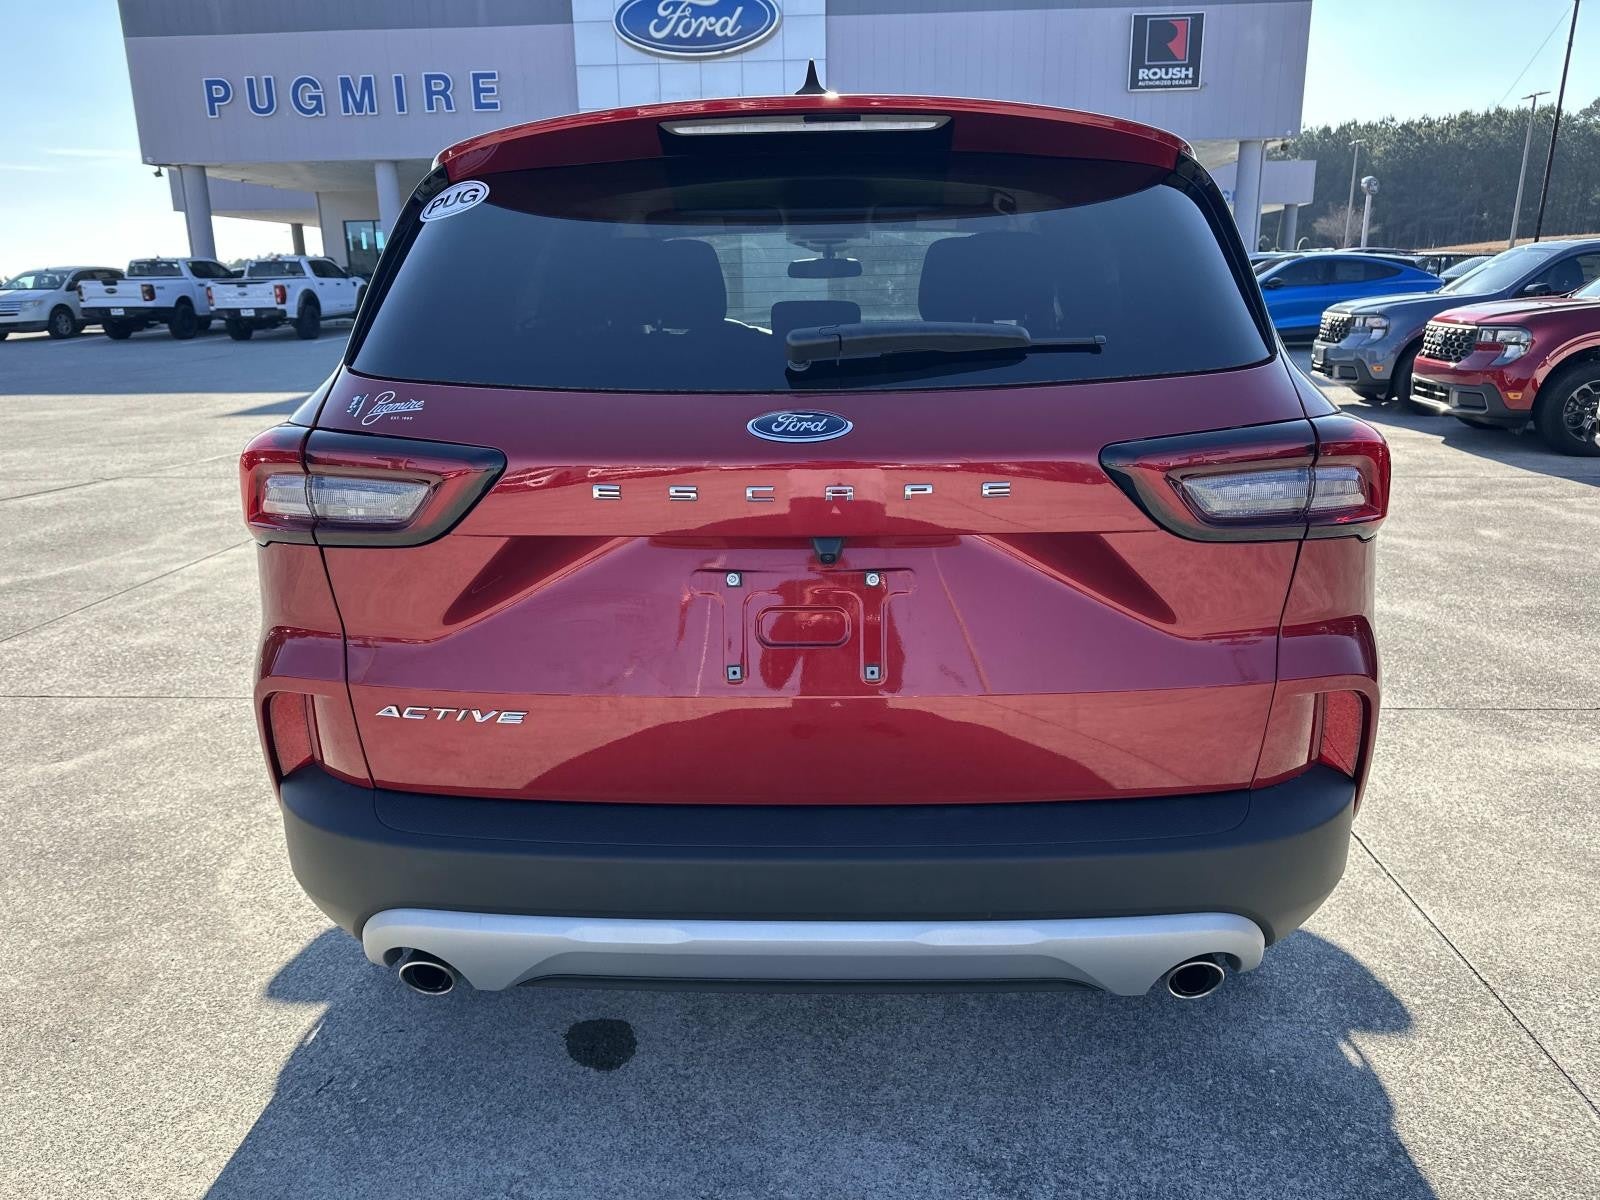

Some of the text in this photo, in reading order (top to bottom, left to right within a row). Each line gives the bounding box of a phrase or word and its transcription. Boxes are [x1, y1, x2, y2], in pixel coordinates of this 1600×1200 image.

[649, 0, 743, 39] Ford
[1138, 67, 1193, 80] ROUSH
[202, 71, 501, 118] PUGMIRE
[427, 188, 480, 215] PUG
[361, 391, 424, 426] Pugmire
[771, 414, 828, 432] Ford
[592, 481, 1011, 502] ESCAPE
[375, 704, 529, 724] ACTIVE
